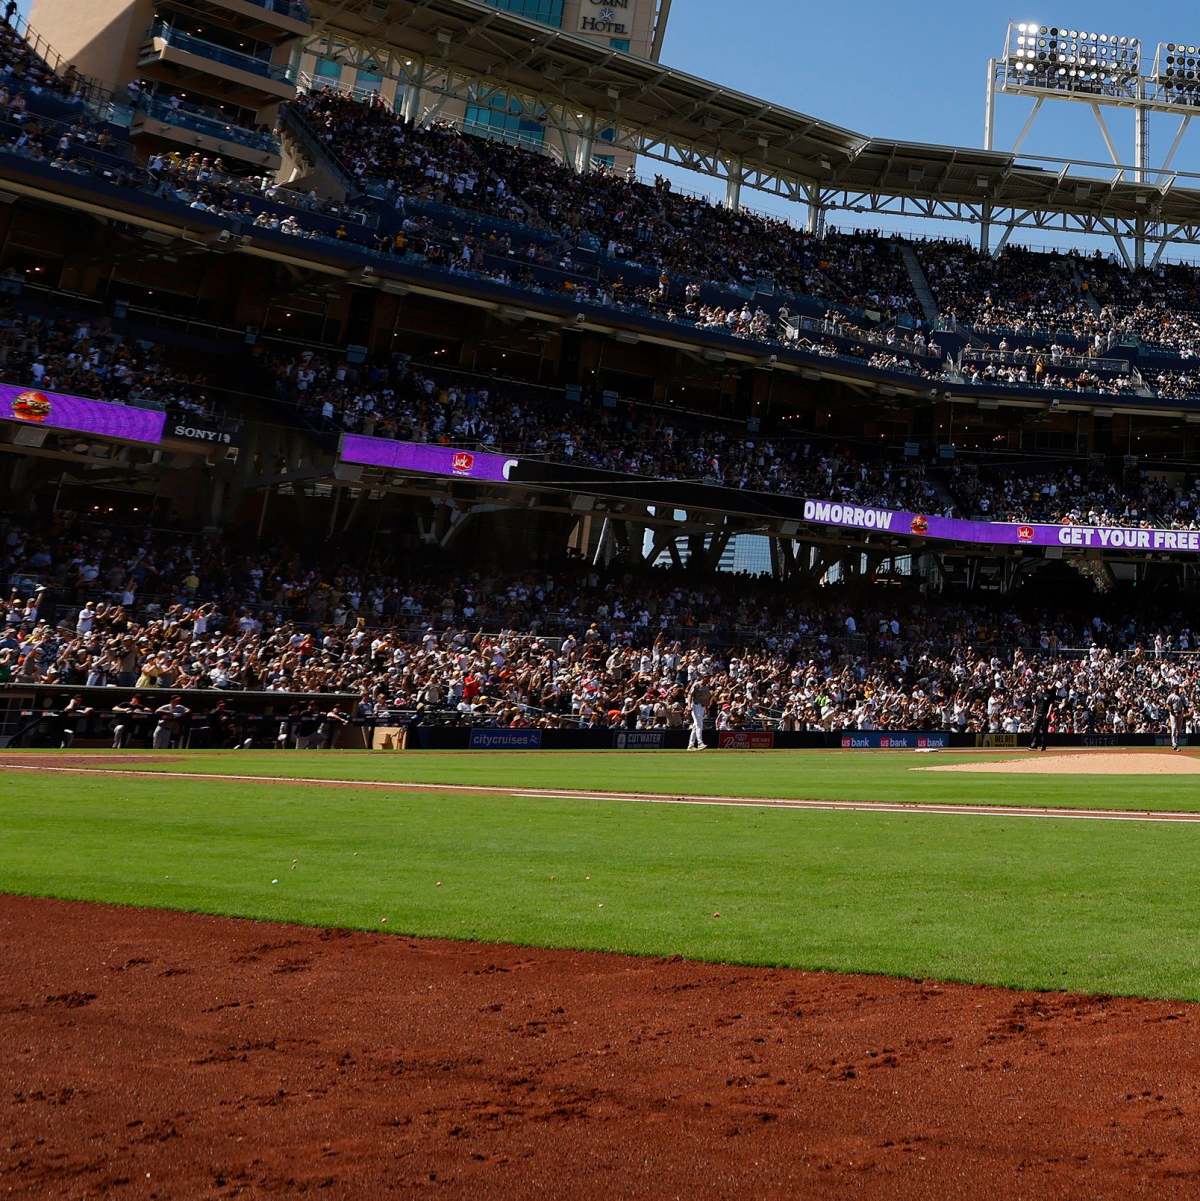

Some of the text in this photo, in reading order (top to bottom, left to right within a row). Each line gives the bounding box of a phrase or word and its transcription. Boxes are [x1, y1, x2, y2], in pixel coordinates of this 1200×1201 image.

[581, 16, 628, 34] HOTEL
[174, 425, 217, 441] SONY
[1058, 527, 1094, 545] GET
[1098, 529, 1151, 548] YOUR
[1154, 531, 1199, 549] FREE
[473, 734, 529, 746] citycruises
[627, 733, 661, 743] CUTWATER
